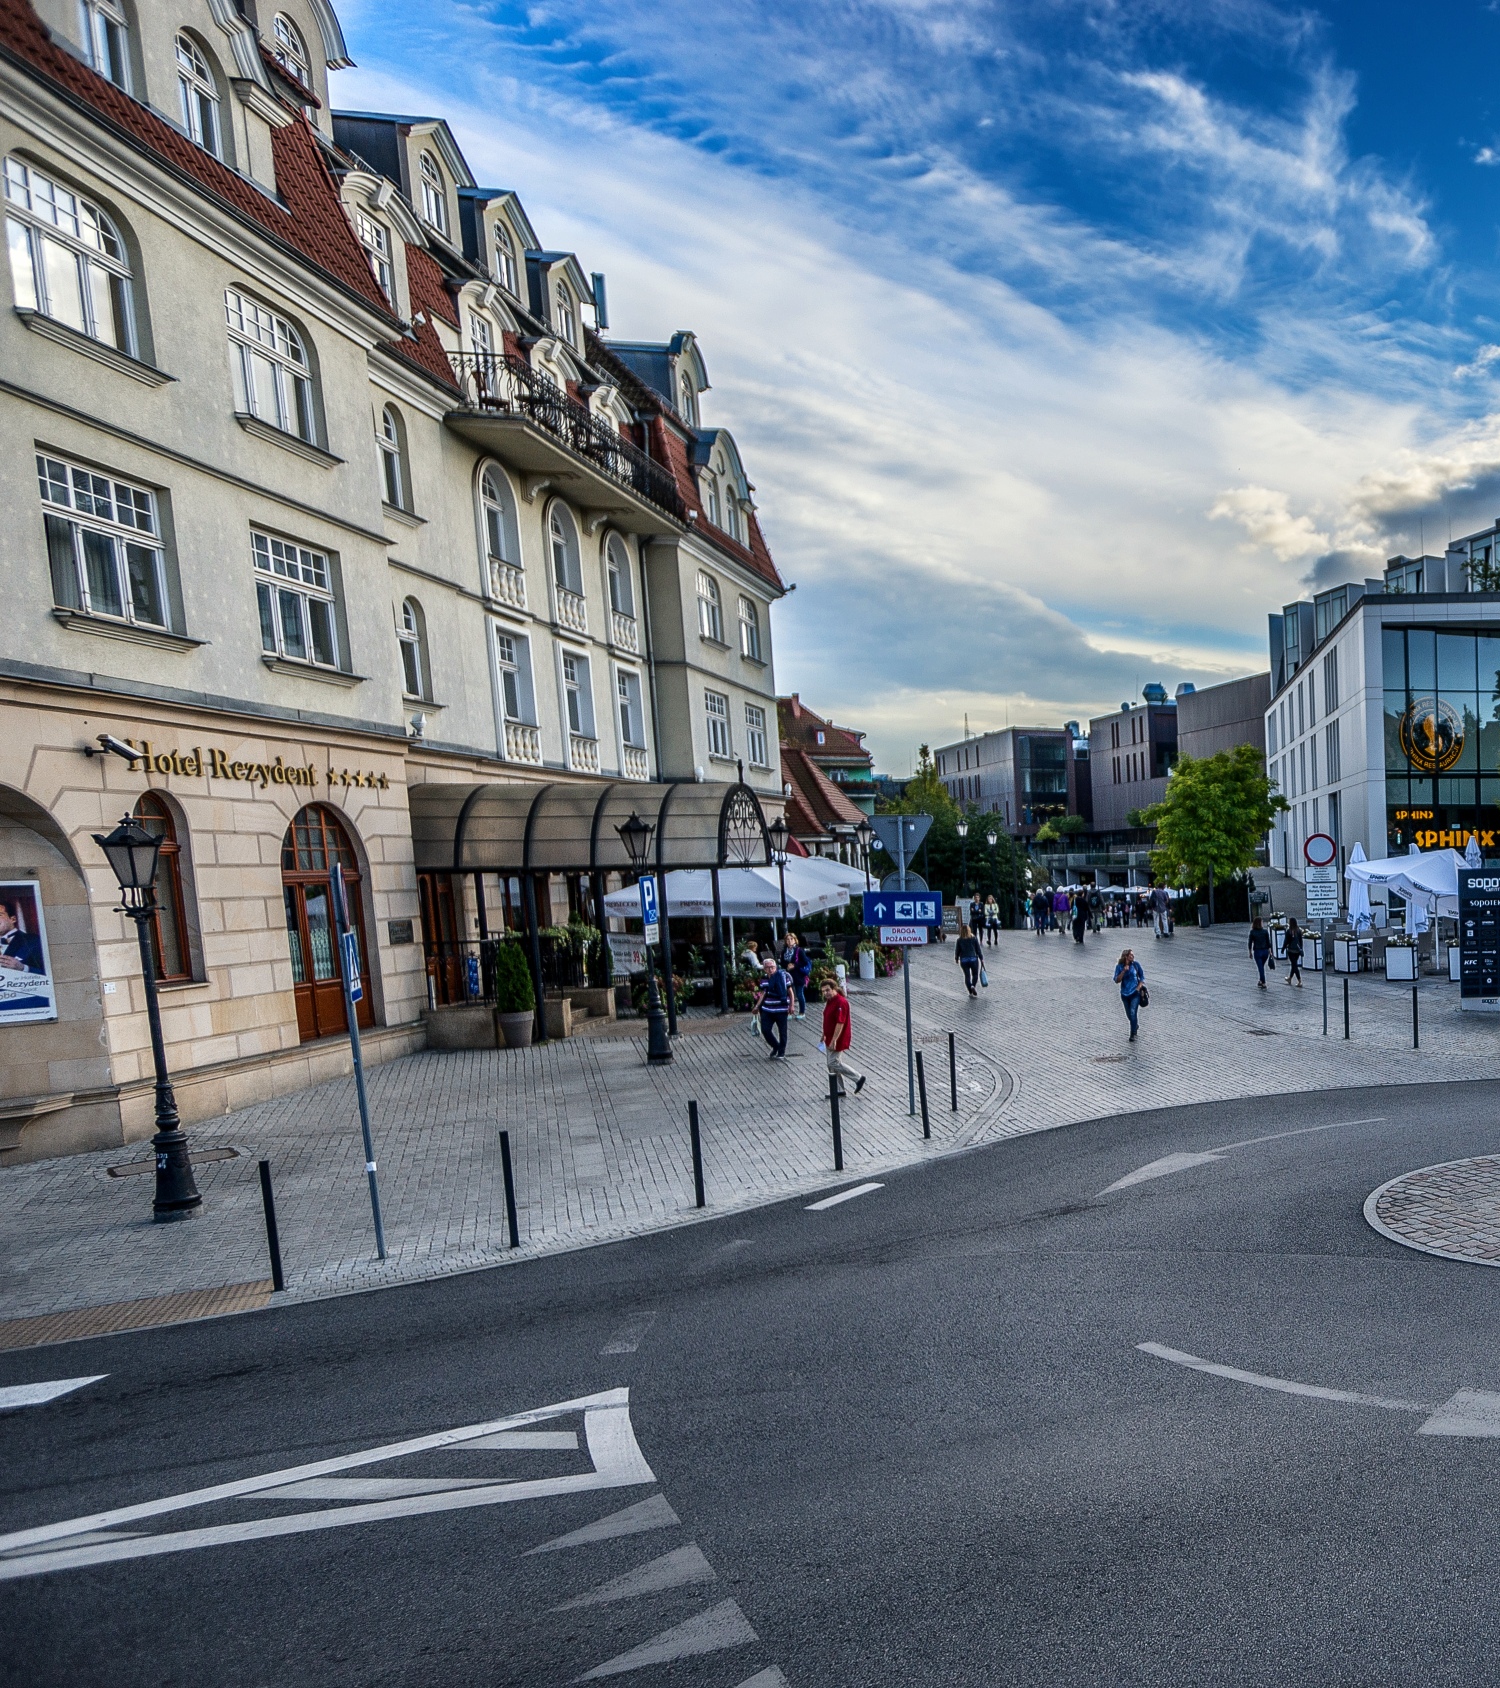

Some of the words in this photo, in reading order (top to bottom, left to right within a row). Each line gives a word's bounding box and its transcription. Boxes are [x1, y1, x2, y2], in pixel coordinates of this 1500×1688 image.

[1422, 700, 1459, 726] RESAURACJE
[124, 738, 206, 777] Hotel
[208, 747, 318, 789] Rezydent
[1423, 744, 1460, 769] RESAURACJE
[1415, 830, 1496, 847] SPHINX
[643, 880, 653, 911] P
[6, 979, 50, 988] Rezydent
